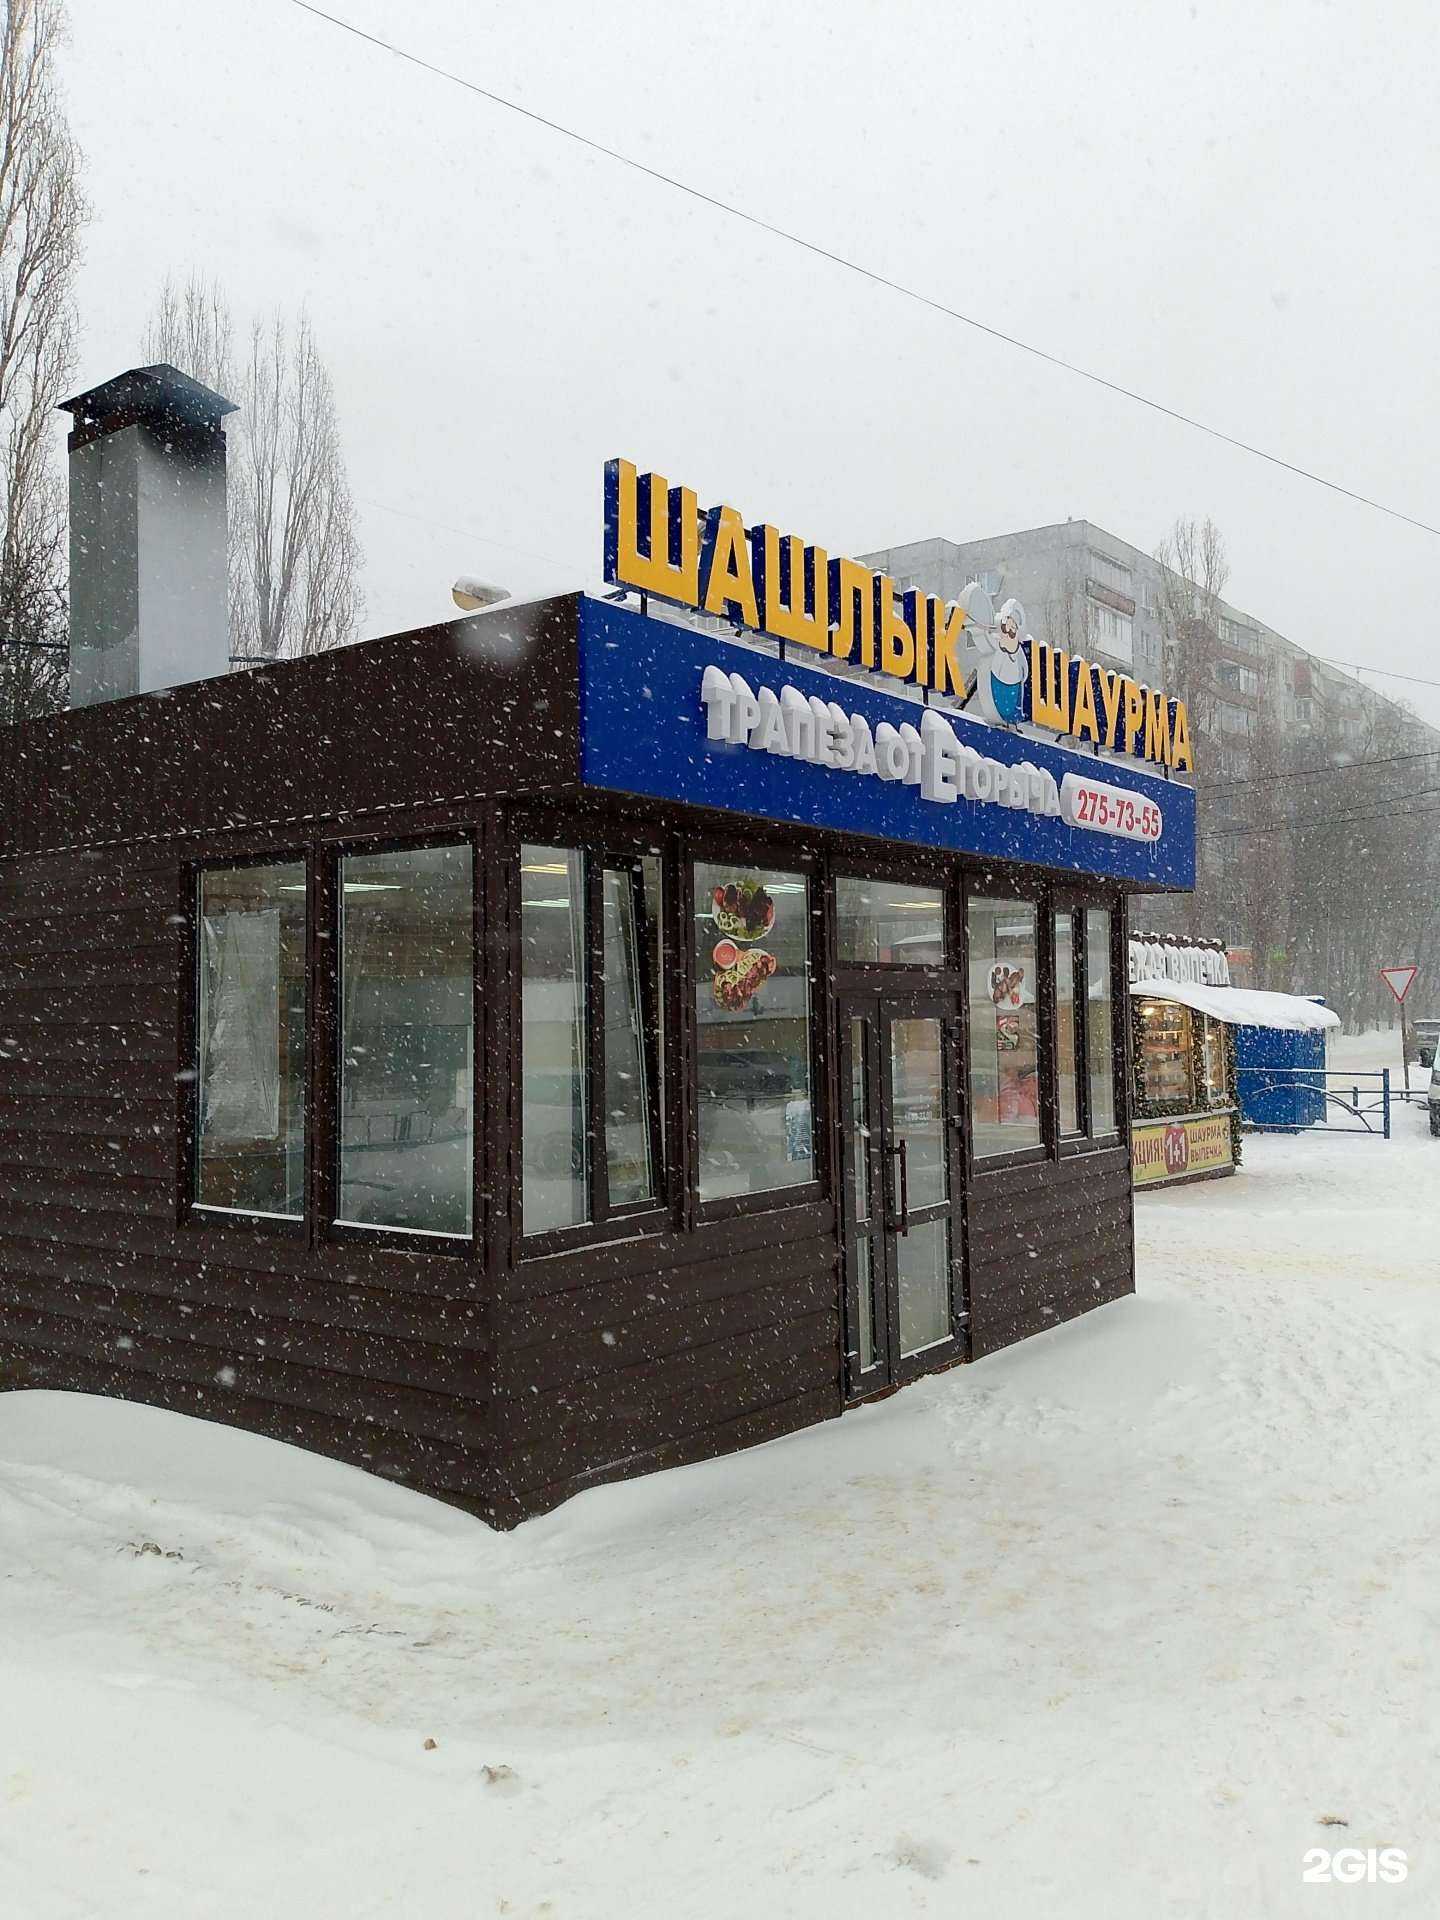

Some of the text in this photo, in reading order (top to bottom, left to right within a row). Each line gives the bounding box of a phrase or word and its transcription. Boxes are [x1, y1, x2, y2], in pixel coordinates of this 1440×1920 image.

[604, 457, 1193, 773] ШАШЛЫК ШАУРМА
[702, 675, 878, 775] ТРАПЕЗА
[875, 730, 926, 784] ОТ
[1077, 789, 1161, 837] 275-73-55
[1166, 1131, 1186, 1165] 1+1
[1189, 1124, 1222, 1144] ШАУРМА
[1190, 1144, 1223, 1163] ВЫПЕЧКА
